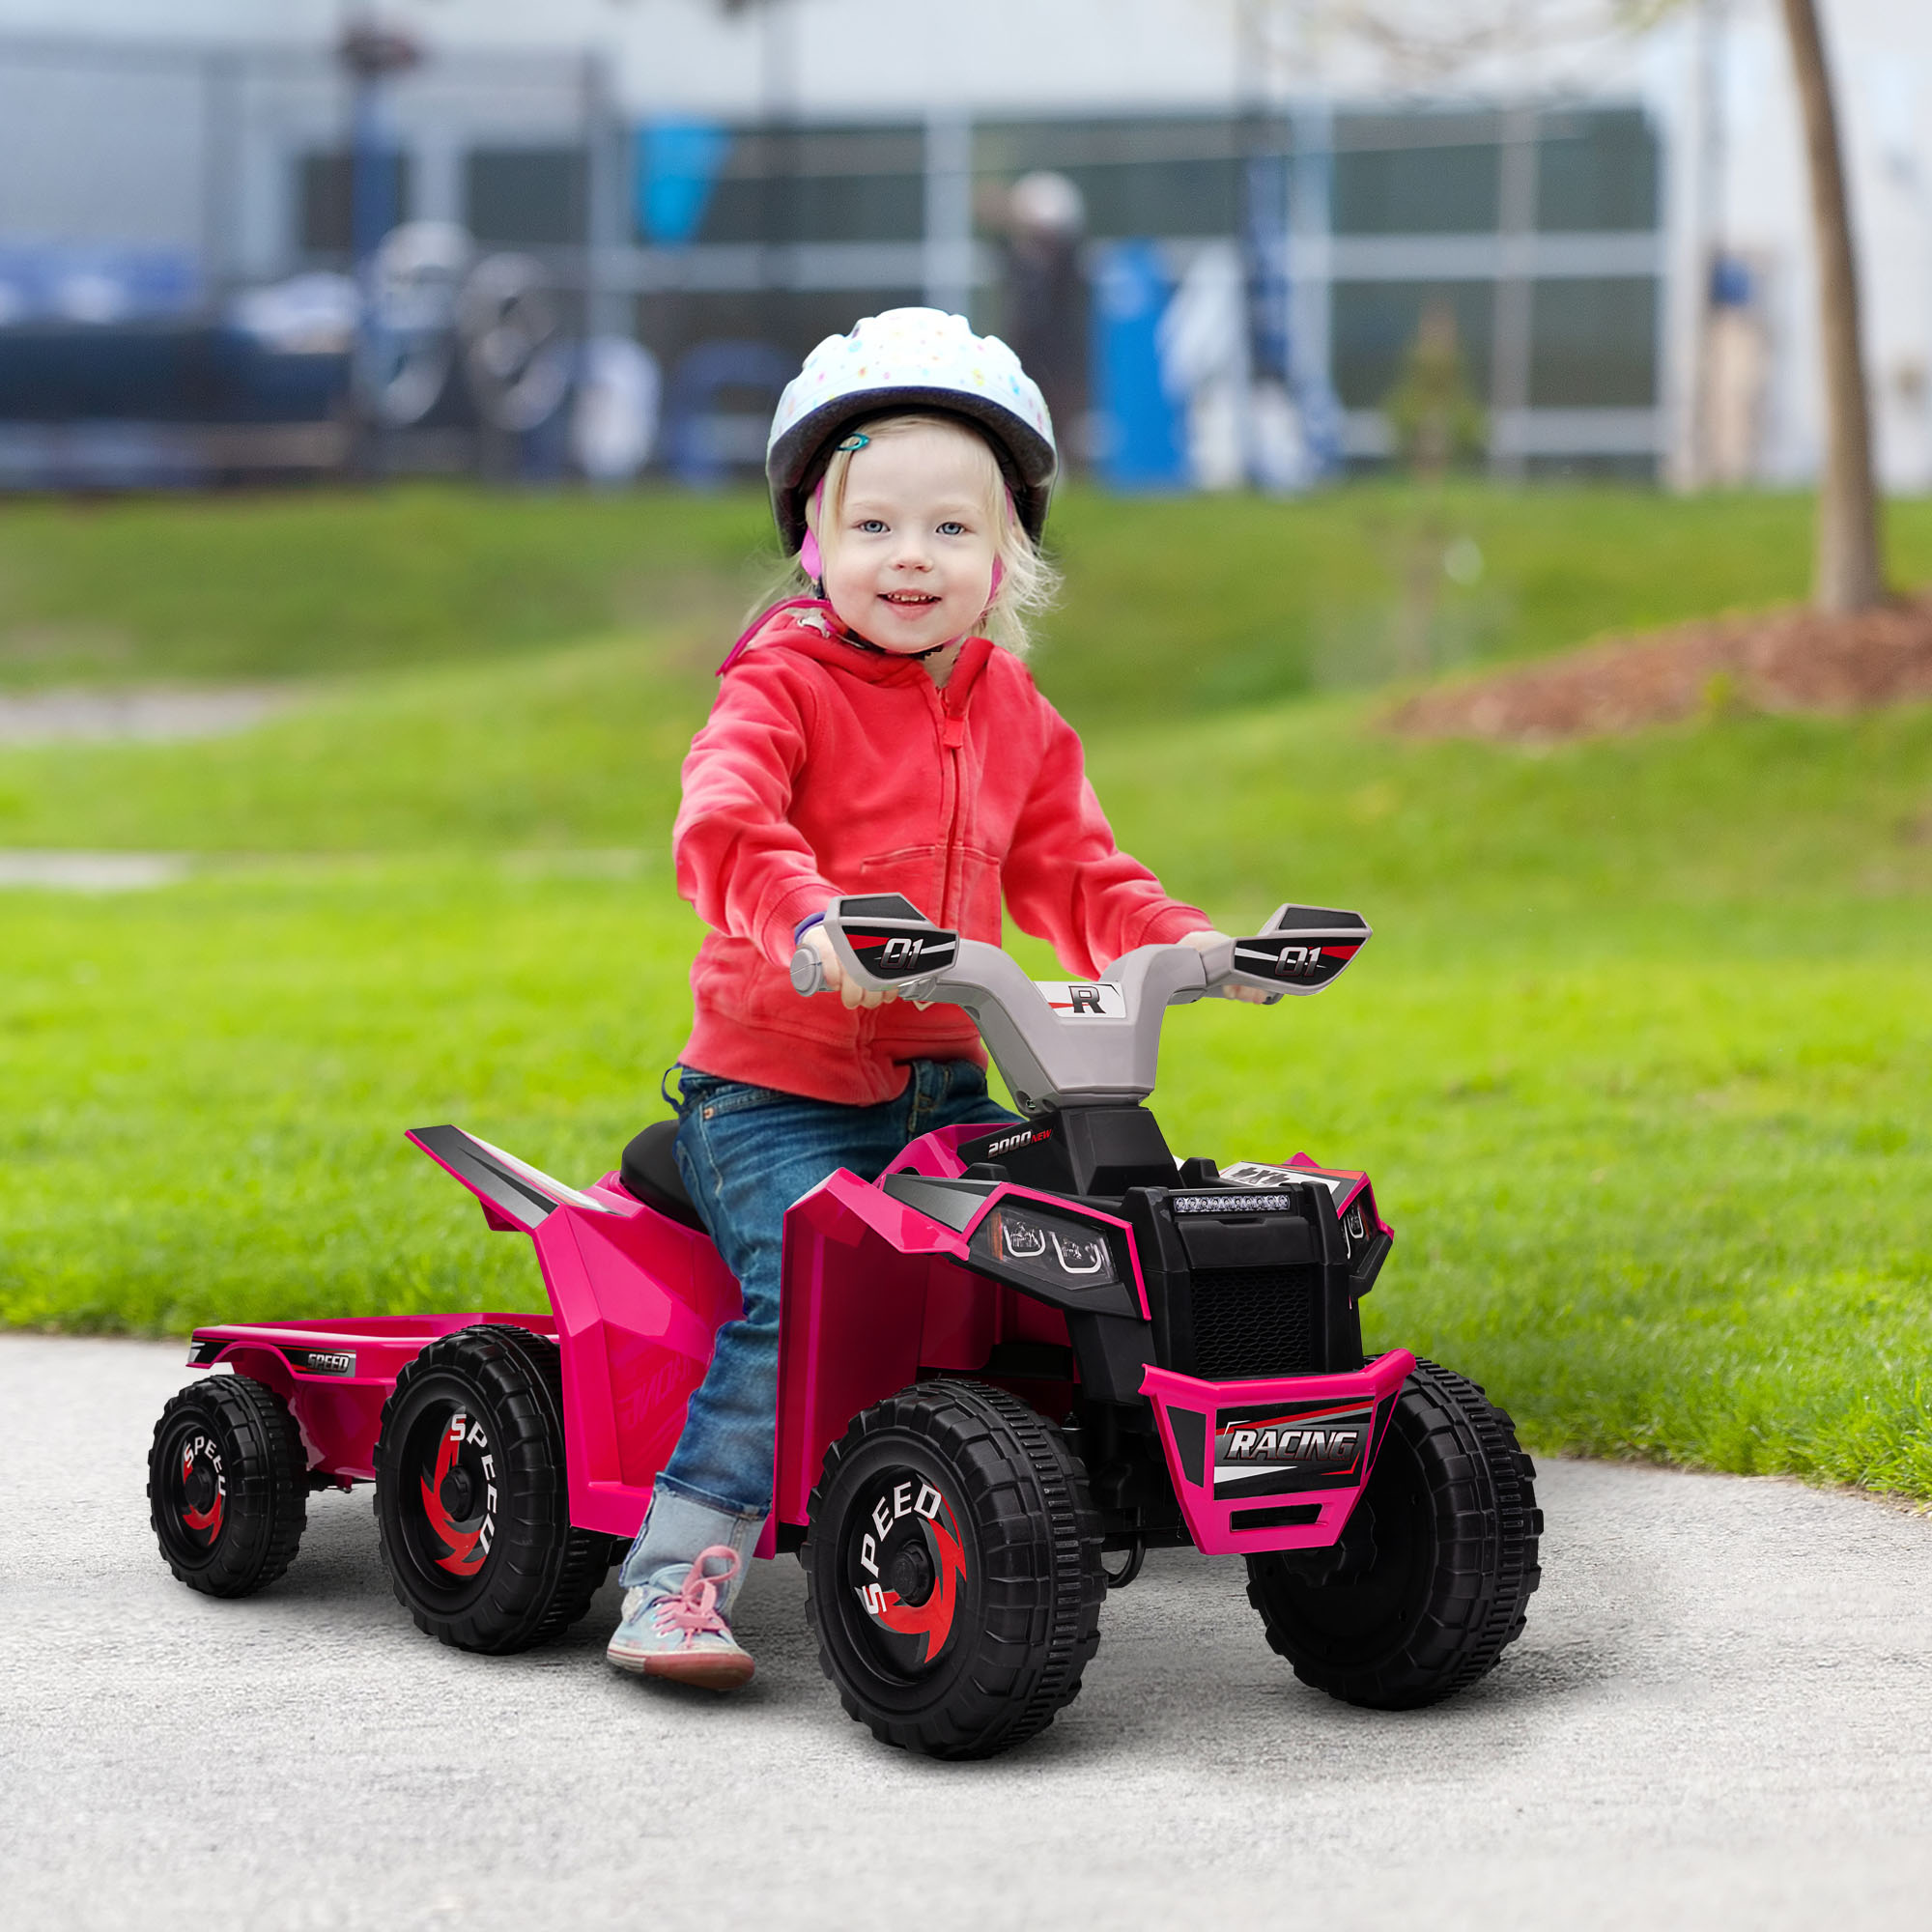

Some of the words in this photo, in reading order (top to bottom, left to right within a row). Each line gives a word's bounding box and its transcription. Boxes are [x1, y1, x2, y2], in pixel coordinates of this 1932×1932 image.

[880, 937, 924, 969] 01
[1275, 947, 1321, 976] 01
[1068, 985, 1107, 1013] R
[987, 1129, 1033, 1158] 2000
[1031, 1128, 1052, 1144] NEW
[307, 1353, 350, 1372] SPEED
[1224, 1429, 1359, 1461] RACING
[860, 1481, 942, 1615] SPEED
